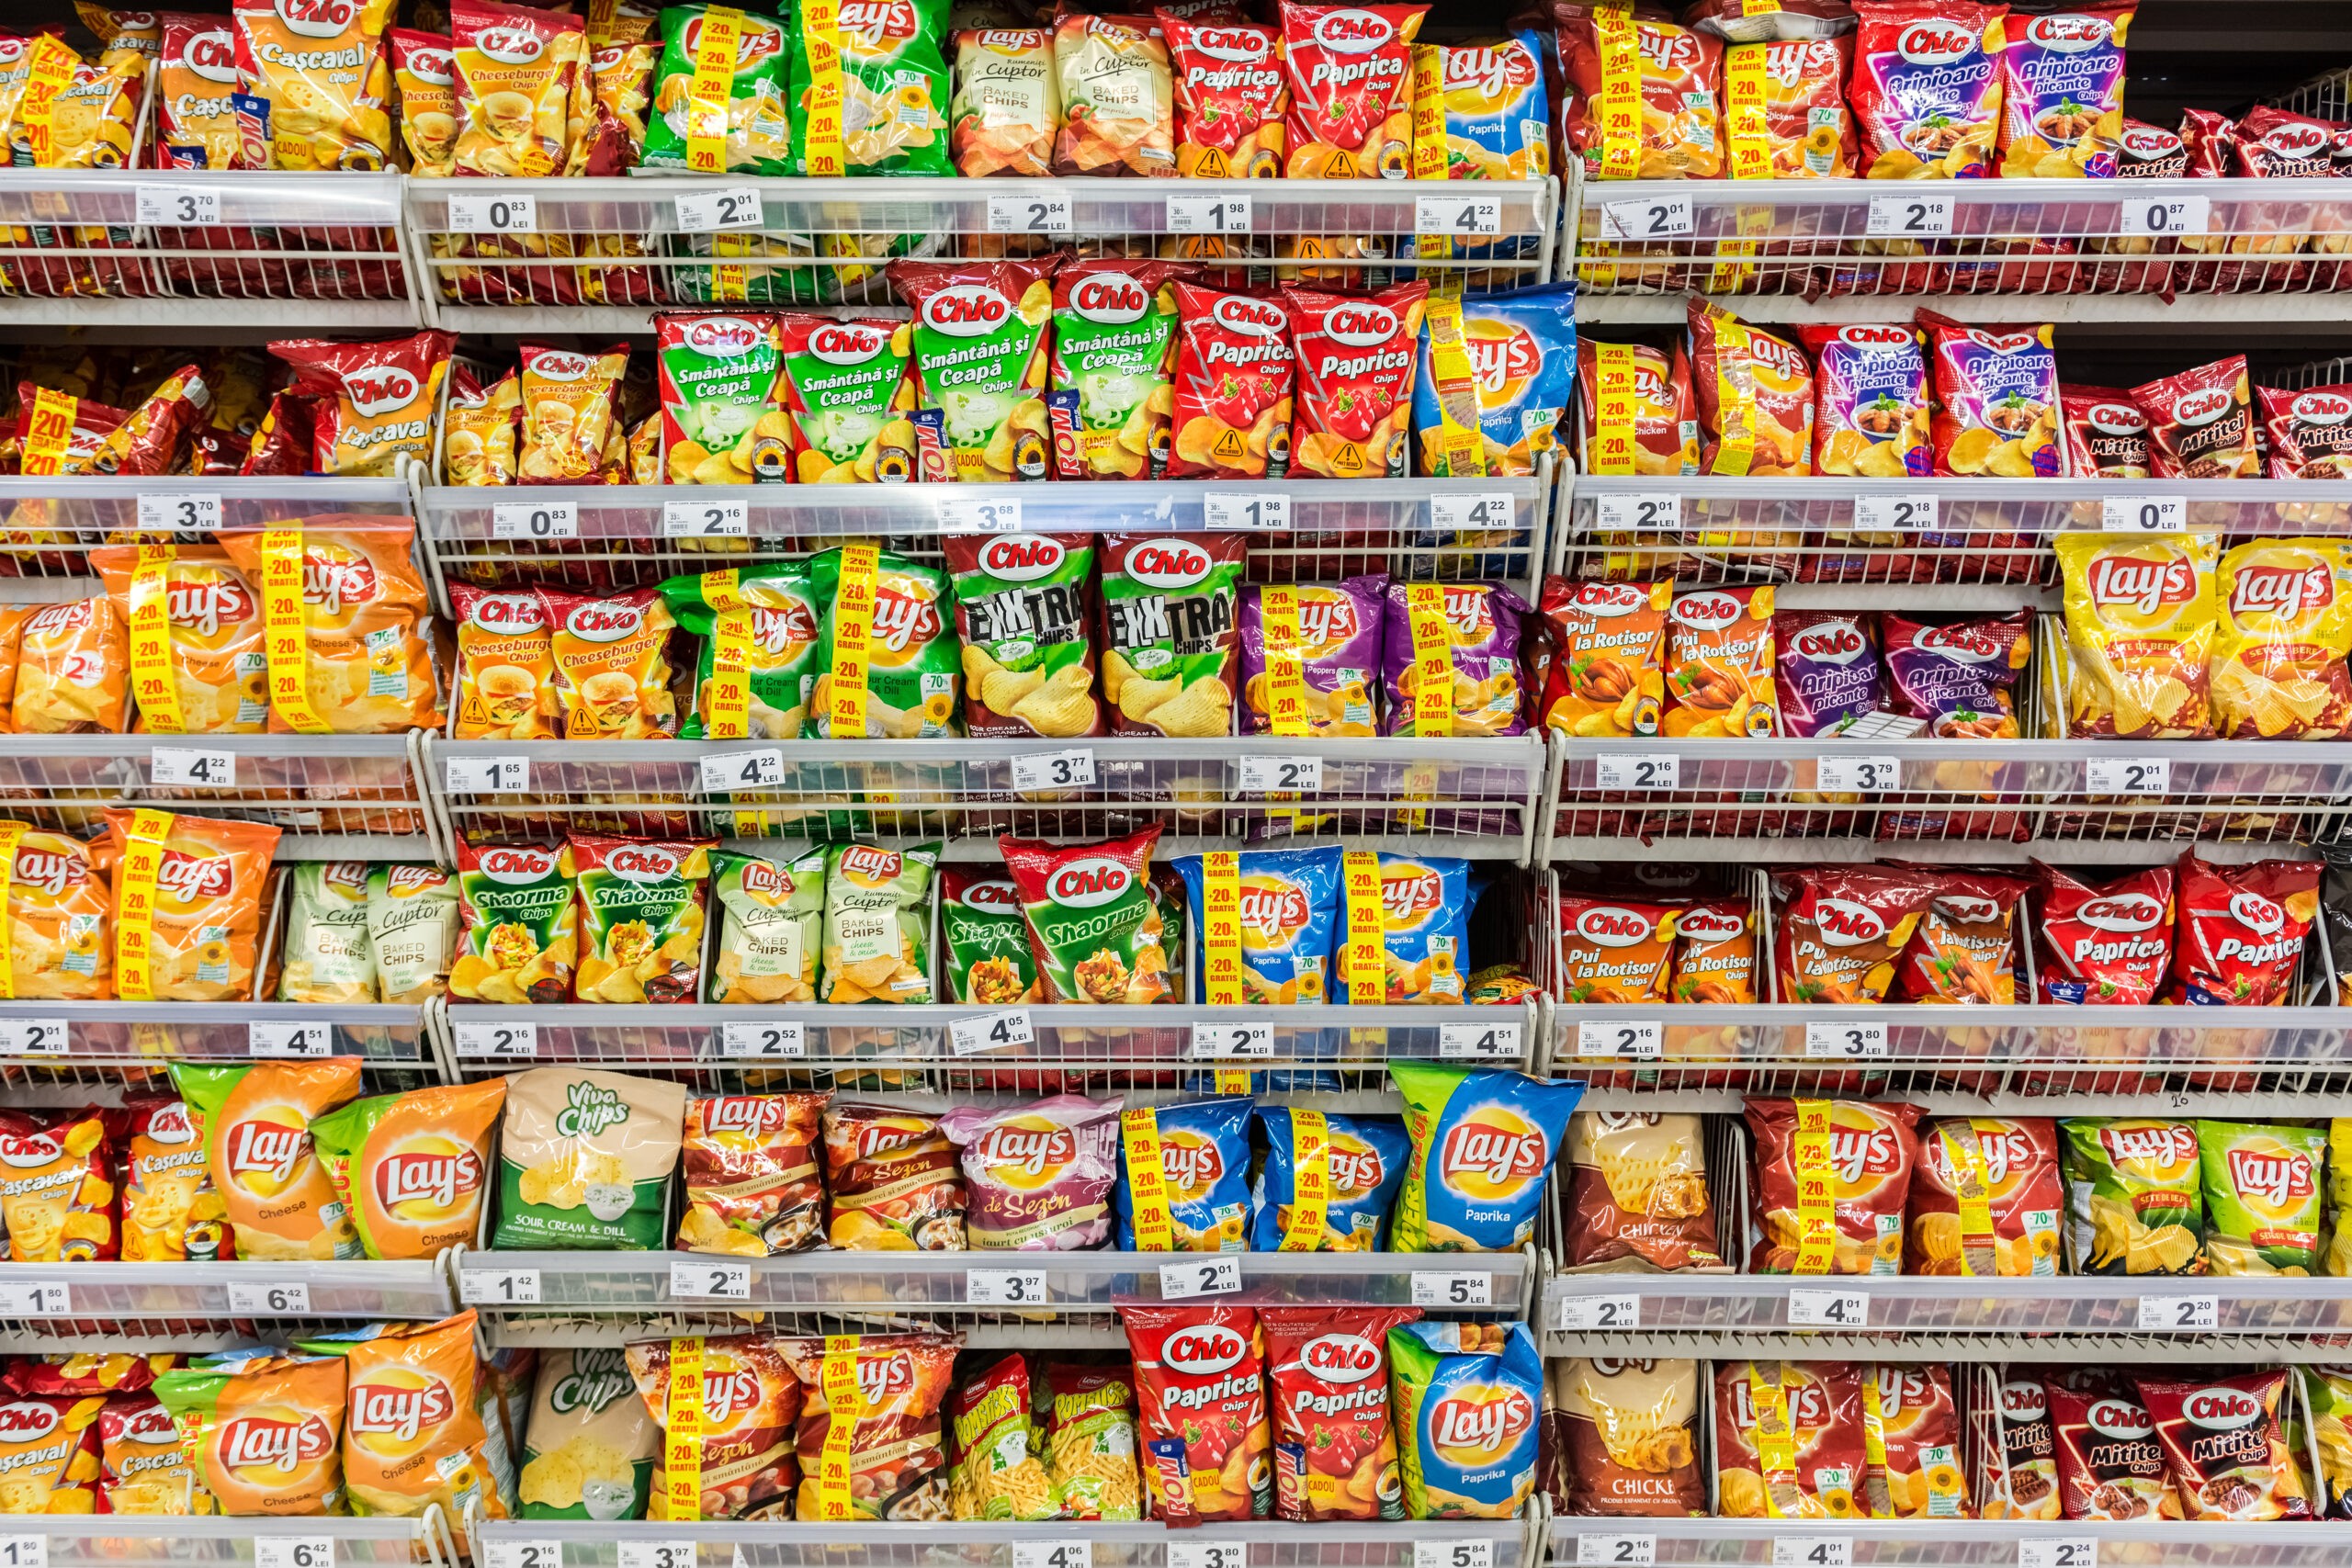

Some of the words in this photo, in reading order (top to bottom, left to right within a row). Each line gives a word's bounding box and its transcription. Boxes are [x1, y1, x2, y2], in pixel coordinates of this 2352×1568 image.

[1747, 3, 1776, 13] GRATIS
[1321, 17, 1386, 44] Chio
[982, 30, 1036, 51] Lay's
[1311, 55, 1402, 87] Paprica
[2022, 56, 2118, 78] Aripioare
[513, 81, 537, 89] Chips
[983, 86, 1029, 101] BAKED
[1367, 80, 1391, 91] Chips
[1641, 85, 1673, 95] Chicken
[2034, 77, 2091, 95] picante
[983, 96, 1028, 109] CHIPS
[2079, 91, 2103, 100] Chips
[1469, 123, 1506, 134] Paprika
[809, 134, 838, 143] GRATIS
[277, 141, 307, 157] CADOU
[932, 296, 1003, 322] Chio
[1331, 310, 1393, 333] Chio
[816, 333, 877, 352] Chio
[922, 338, 1012, 371] Smântână
[940, 358, 1002, 388] Ceapă
[1320, 350, 1408, 379] Paprica
[804, 368, 881, 391] Smântână
[982, 379, 1013, 394] Chips
[1374, 373, 1398, 383] Chips
[350, 377, 412, 404] Chio
[695, 377, 751, 398] Ceapă
[733, 394, 760, 405] Chips
[820, 389, 874, 407] Ceapă
[2180, 395, 2225, 417] Chio
[856, 402, 883, 413] Chips
[1054, 408, 1080, 476] ROM
[2179, 411, 2245, 456] Mititei
[2214, 434, 2242, 448] Chips
[1601, 455, 1631, 466] GRATIS
[988, 541, 1057, 568] Chio
[2097, 558, 2188, 615] Lay's
[1678, 599, 1736, 619] Chio
[1035, 627, 1074, 645] CHIPS
[1566, 620, 1596, 637] Pui
[312, 638, 350, 649] Cheese
[837, 639, 865, 651] GRATIS
[1174, 639, 1212, 654] CHIPS
[1576, 636, 1591, 651] la
[1594, 630, 1654, 648] Rotisor
[563, 637, 658, 668] Cheeseburger
[1621, 645, 1645, 657] Chips
[67, 657, 84, 680] 2
[609, 654, 637, 668] Chips
[1307, 666, 1336, 676] Peppers
[884, 685, 899, 695] Dill
[715, 702, 743, 712] GRATIS
[1812, 688, 1868, 713] picante
[1420, 711, 1447, 720] GRATIS
[212, 775, 226, 784] LEI
[1074, 774, 1089, 783] LEI
[487, 851, 549, 874] Chio
[842, 846, 898, 880] Lay's
[1057, 868, 1125, 897] Chio
[477, 886, 567, 908] Shaorma
[521, 908, 551, 920] Chips
[2085, 901, 2156, 922] Chio
[158, 920, 188, 931] Cheese
[842, 919, 884, 928] BAKED
[1047, 900, 1148, 944] Shaorma
[1352, 923, 1379, 933] GRATIS
[1584, 913, 1645, 936] Chio
[842, 927, 884, 938] CHIPS
[748, 943, 787, 955] CHIPS
[1569, 949, 1600, 964] Pui
[2075, 936, 2165, 964] Paprica
[752, 957, 775, 966] cheese
[1253, 957, 1281, 966] Paprika
[1577, 964, 1594, 977] la
[1596, 962, 1656, 977] Rotisor
[2126, 961, 2150, 972] Chips
[1623, 976, 1647, 987] Chips
[571, 1082, 616, 1107] Viva
[560, 1103, 628, 1135] Chips
[982, 1128, 1068, 1175] Lay's
[1448, 1128, 1540, 1183] Lay's
[387, 1154, 476, 1207] Lay's
[2237, 1154, 2307, 1207] Lay's
[1299, 1190, 1324, 1200] GRATIS
[258, 1200, 307, 1220] Cheese
[985, 1197, 1001, 1213] de
[1004, 1193, 1071, 1220] Sezon
[1466, 1210, 1510, 1222] Paprika
[514, 1214, 545, 1228] SOUR
[548, 1220, 586, 1233] CREAM
[590, 1224, 599, 1234] &
[604, 1226, 627, 1236] DILL
[422, 1230, 469, 1247] Cheese
[982, 1237, 1011, 1247] iaurt
[1170, 1335, 1239, 1361] Chio
[1163, 1373, 1259, 1411] Paprica
[1396, 1379, 1413, 1448] VALUE
[2191, 1396, 2254, 1418] Chio
[1438, 1396, 1526, 1451] Lay's
[229, 1420, 320, 1472] Lay's
[2238, 1449, 2267, 1462] Chips
[669, 1463, 696, 1472] GRATIS
[2131, 1461, 2160, 1473] Chips
[1193, 1474, 1219, 1487] CADOU
[1462, 1470, 1506, 1483] Paprika
[263, 1493, 311, 1507] Cheese
